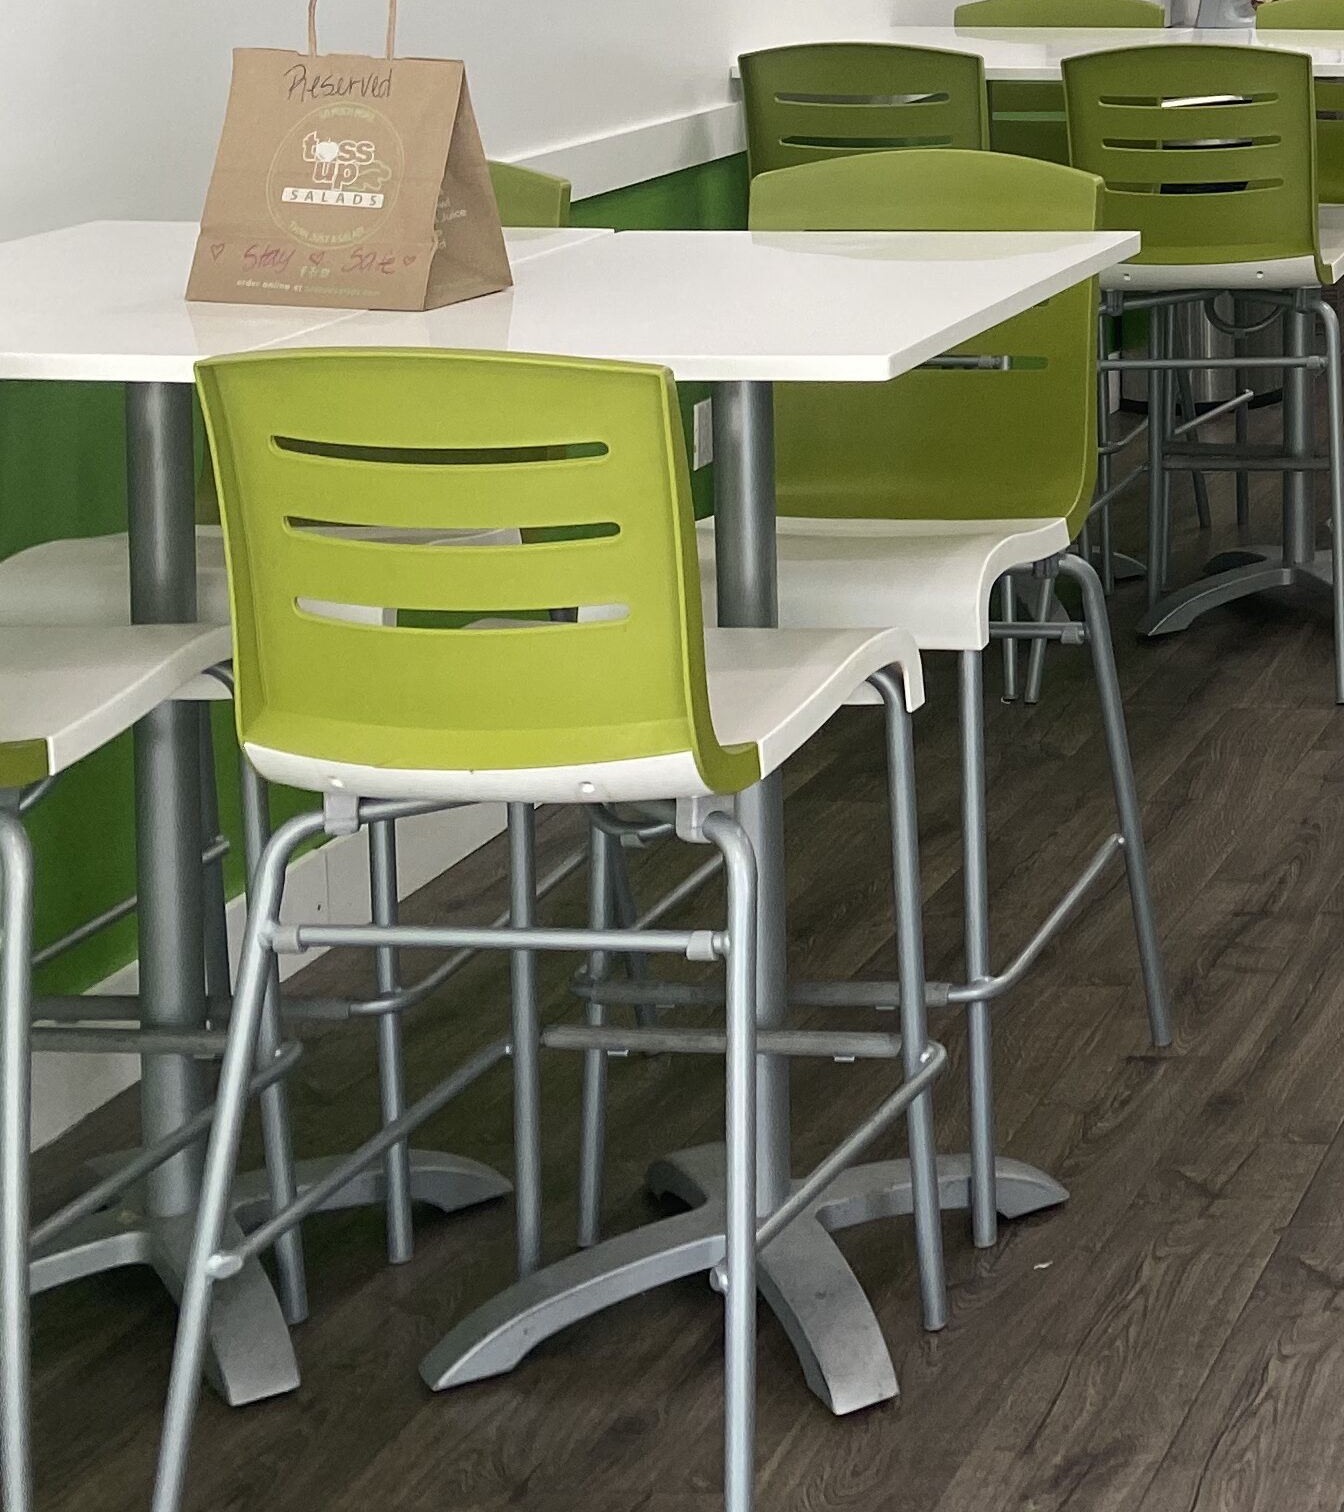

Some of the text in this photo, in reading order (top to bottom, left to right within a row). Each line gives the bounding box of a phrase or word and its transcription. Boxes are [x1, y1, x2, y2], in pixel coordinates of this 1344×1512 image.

[283, 63, 393, 103] Reserved
[312, 159, 360, 191] up
[288, 189, 379, 208] SALADS
[243, 244, 296, 273] Stay
